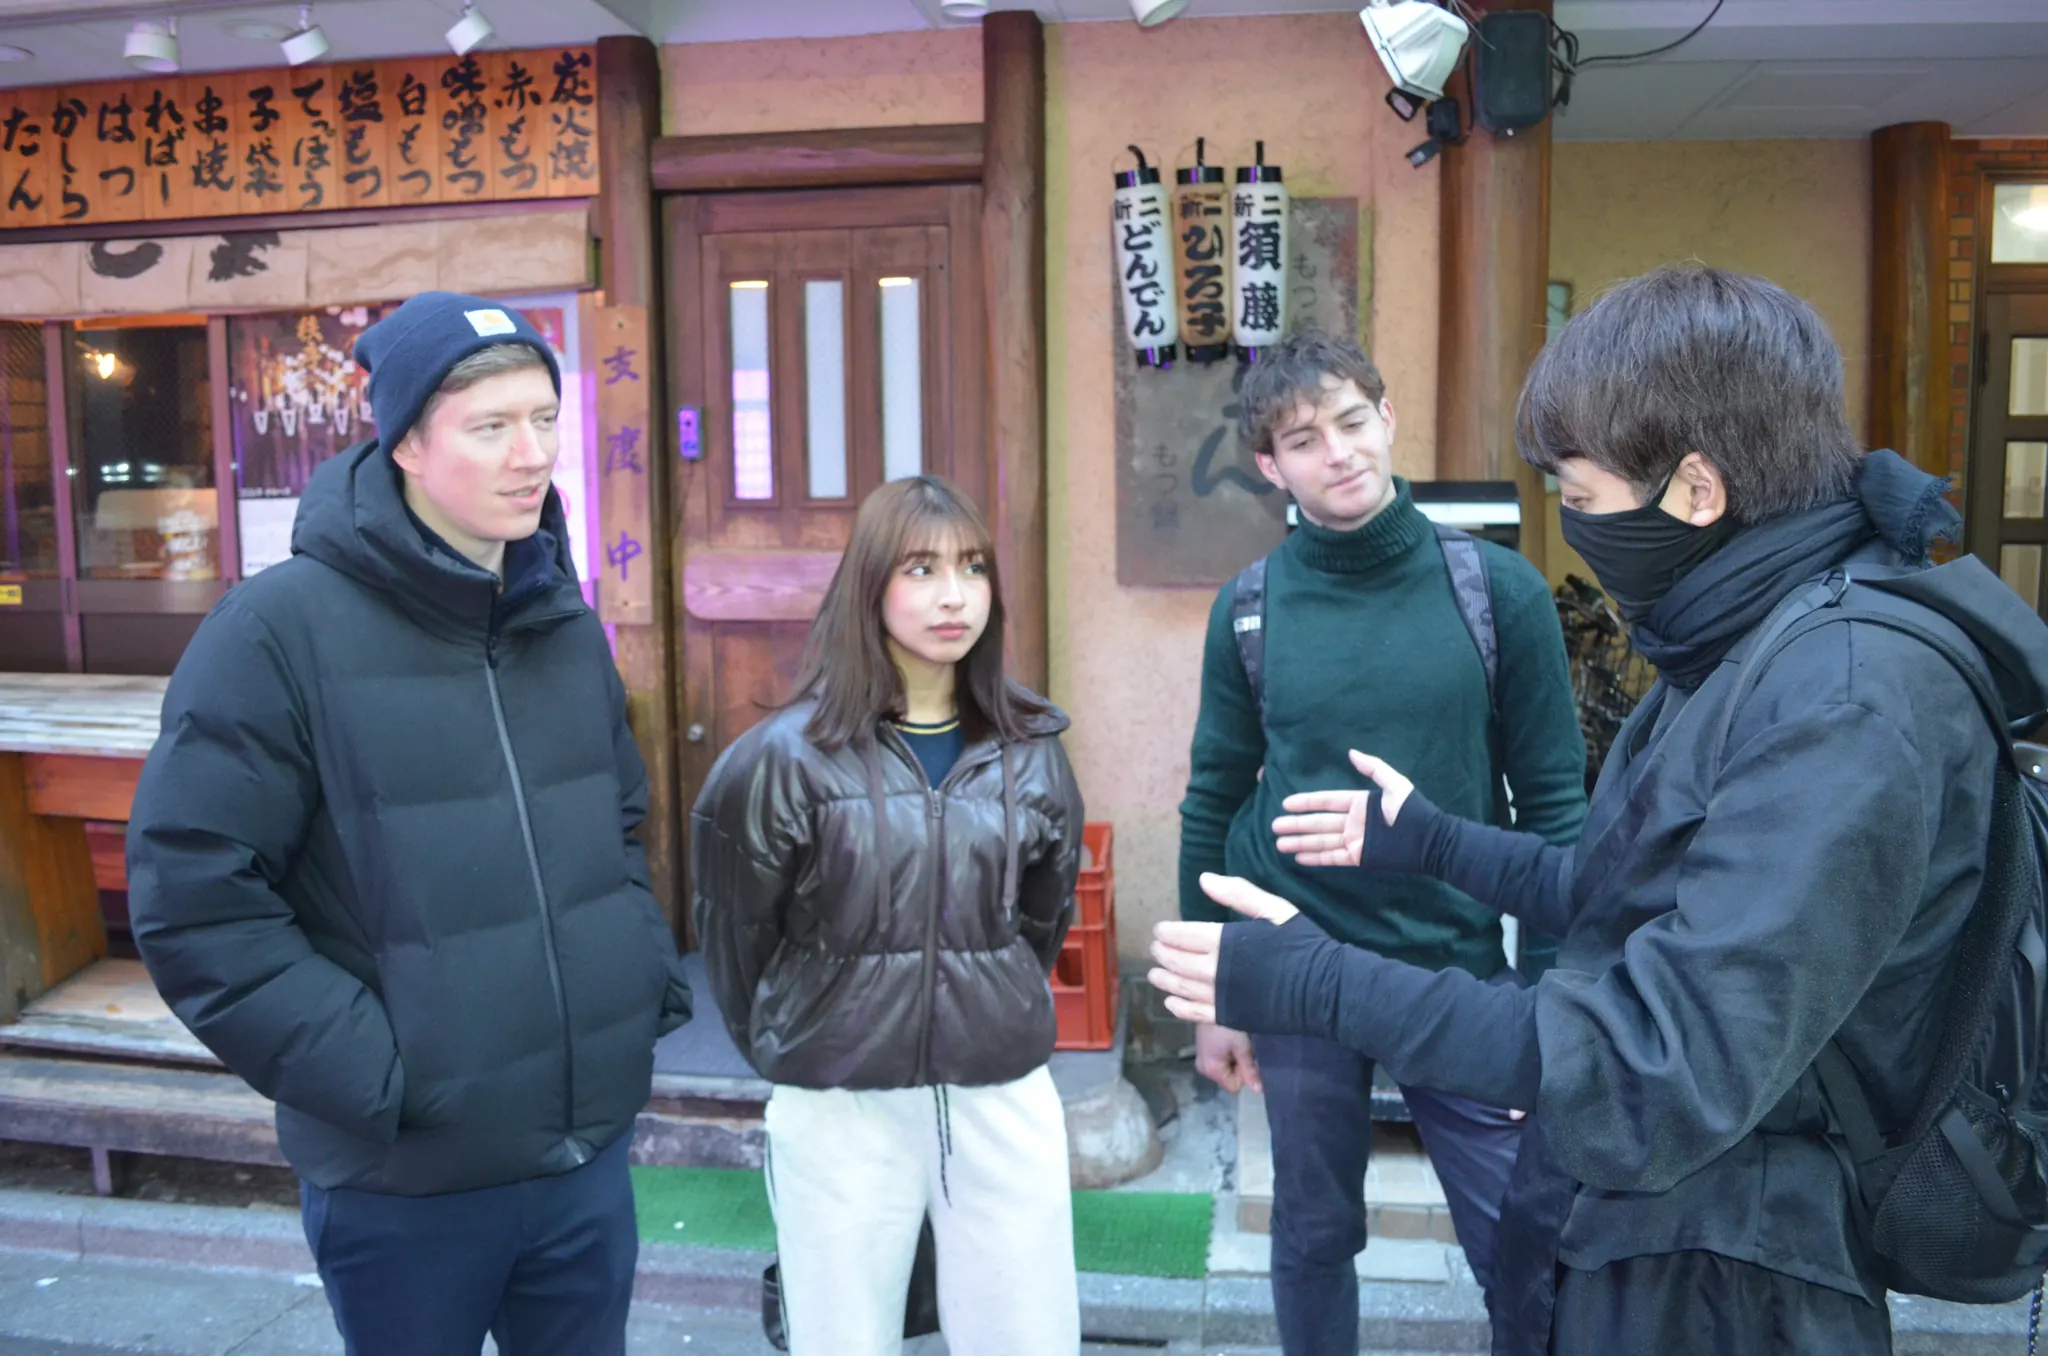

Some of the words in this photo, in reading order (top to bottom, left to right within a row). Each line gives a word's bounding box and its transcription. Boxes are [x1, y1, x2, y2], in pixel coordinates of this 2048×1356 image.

[3, 106, 43, 211] たん
[52, 98, 89, 218] かしら
[97, 93, 136, 196] はつ
[192, 86, 235, 191] 串焼
[243, 85, 284, 197] 子袋
[338, 69, 384, 198] 塩もつ
[397, 73, 432, 197] 白もつ
[441, 54, 488, 195] 味噌もつ
[494, 61, 542, 191] 赤もつ
[549, 51, 597, 180] 炭火焼
[1123, 220, 1166, 337] どんでん
[1182, 224, 1227, 337] ひろ子
[1239, 221, 1282, 331] 須藤
[602, 345, 644, 582] 支度中
